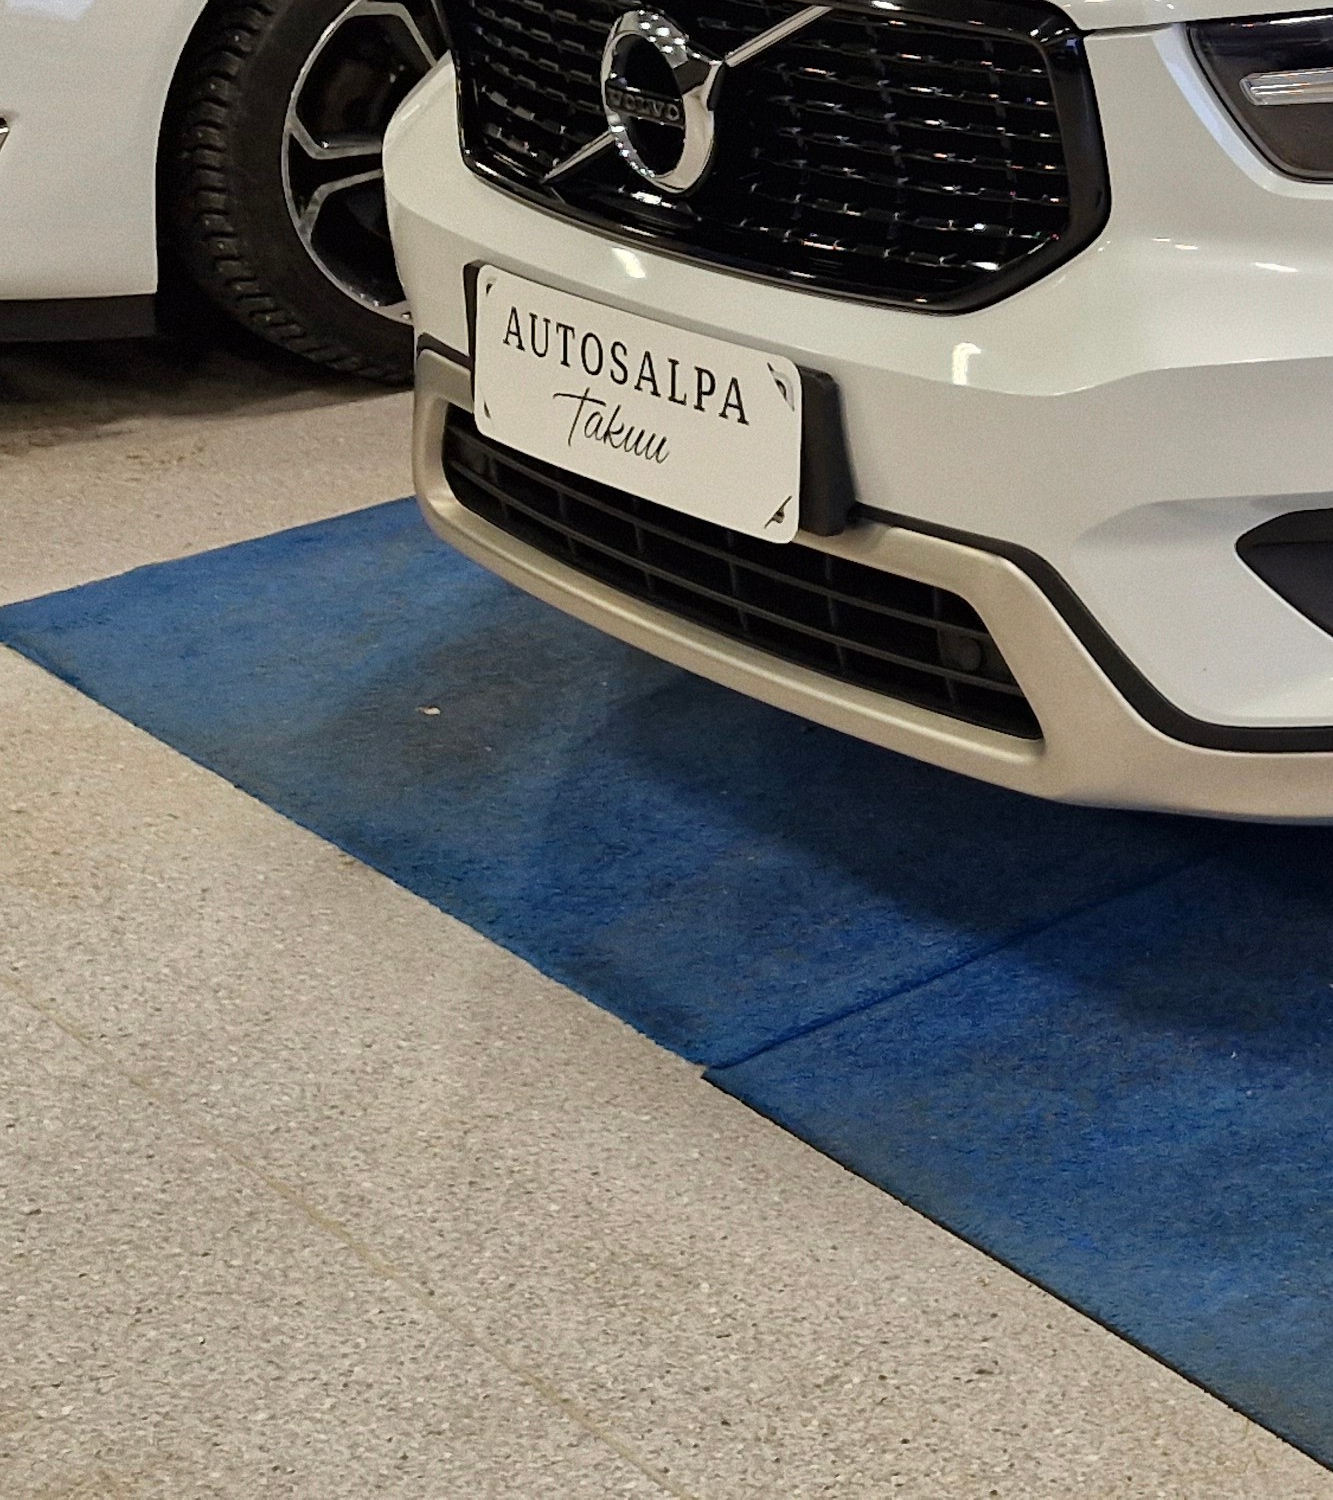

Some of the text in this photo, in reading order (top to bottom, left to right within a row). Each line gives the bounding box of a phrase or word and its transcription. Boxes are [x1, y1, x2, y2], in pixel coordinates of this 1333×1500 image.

[606, 87, 681, 121] VOLVO
[502, 306, 750, 426] AUTOSALPA
[553, 387, 671, 466] Takuu
